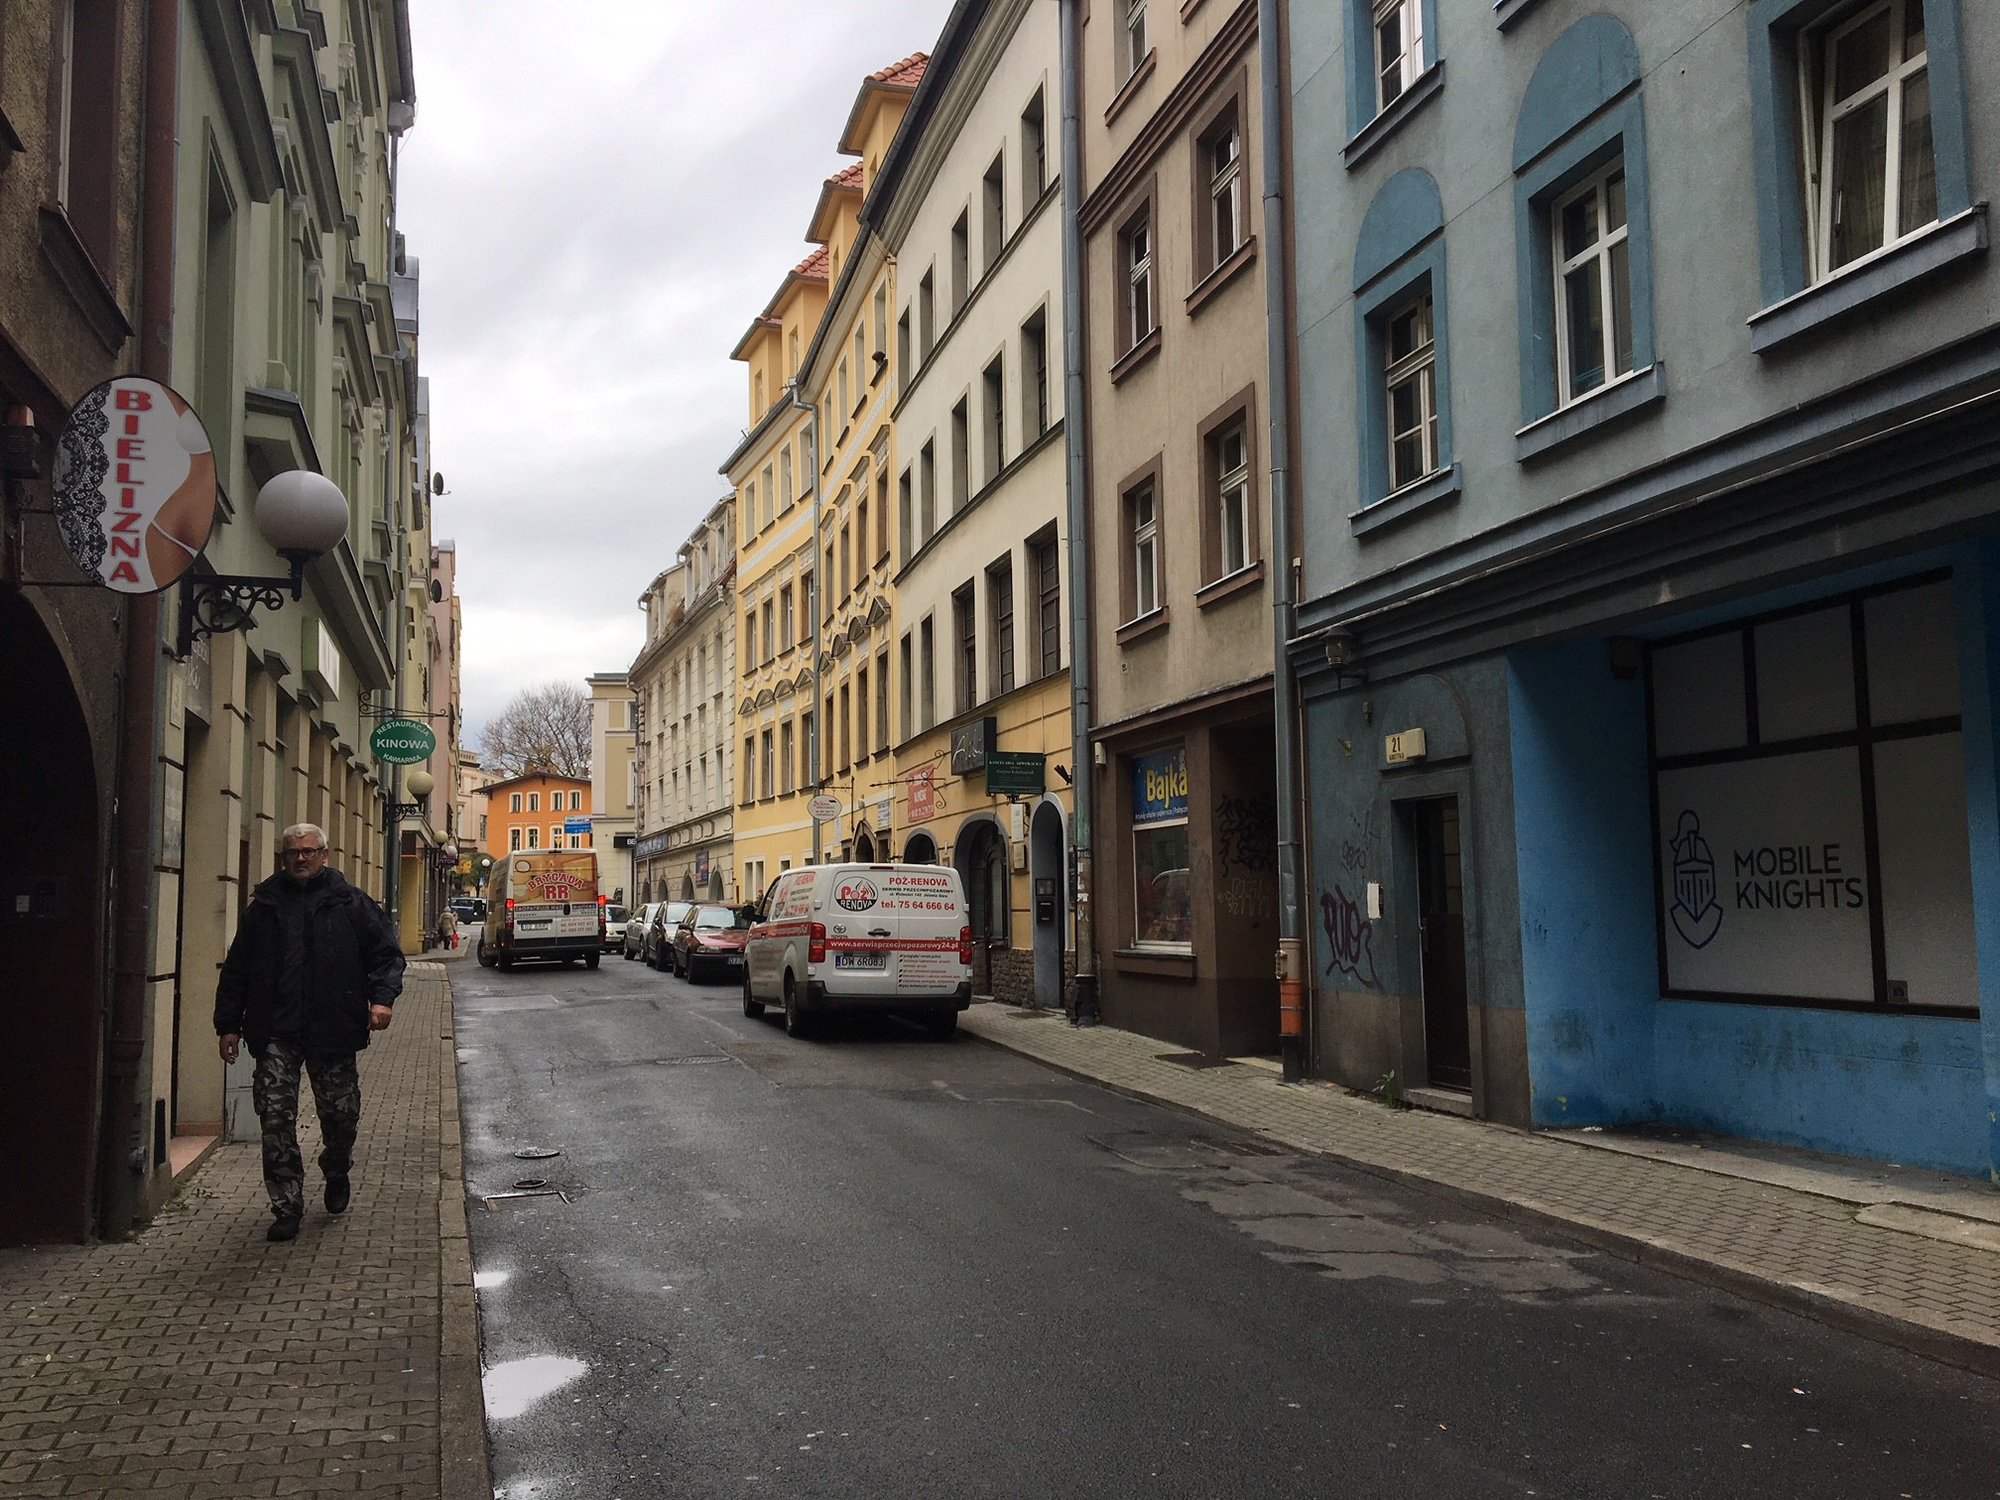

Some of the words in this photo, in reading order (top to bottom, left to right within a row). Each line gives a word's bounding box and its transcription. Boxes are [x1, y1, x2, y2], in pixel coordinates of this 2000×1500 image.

[109, 389, 153, 583] BIELIZNA
[376, 721, 430, 737] RESTAURACJA
[376, 738, 430, 749] KINOWA
[1391, 736, 1401, 753] 21
[382, 753, 422, 763] KAWIARNIA
[1146, 763, 1188, 809] Bajka
[1733, 844, 1842, 877] MOBILE
[527, 872, 584, 891] BRYGADA
[889, 876, 948, 887] POŻ-RENOVA
[544, 884, 570, 901] RR
[1735, 877, 1864, 910] KNIGHTS
[840, 899, 873, 911] RENOVA
[881, 900, 896, 909] tel.
[899, 901, 910, 909] 75
[912, 901, 924, 910] 64
[926, 901, 942, 910] 666
[944, 902, 955, 911] 64
[830, 940, 959, 949] www.serwisprzeciwpozarowy24.pl
[841, 956, 855, 966] DW
[857, 956, 884, 967] 6R083
